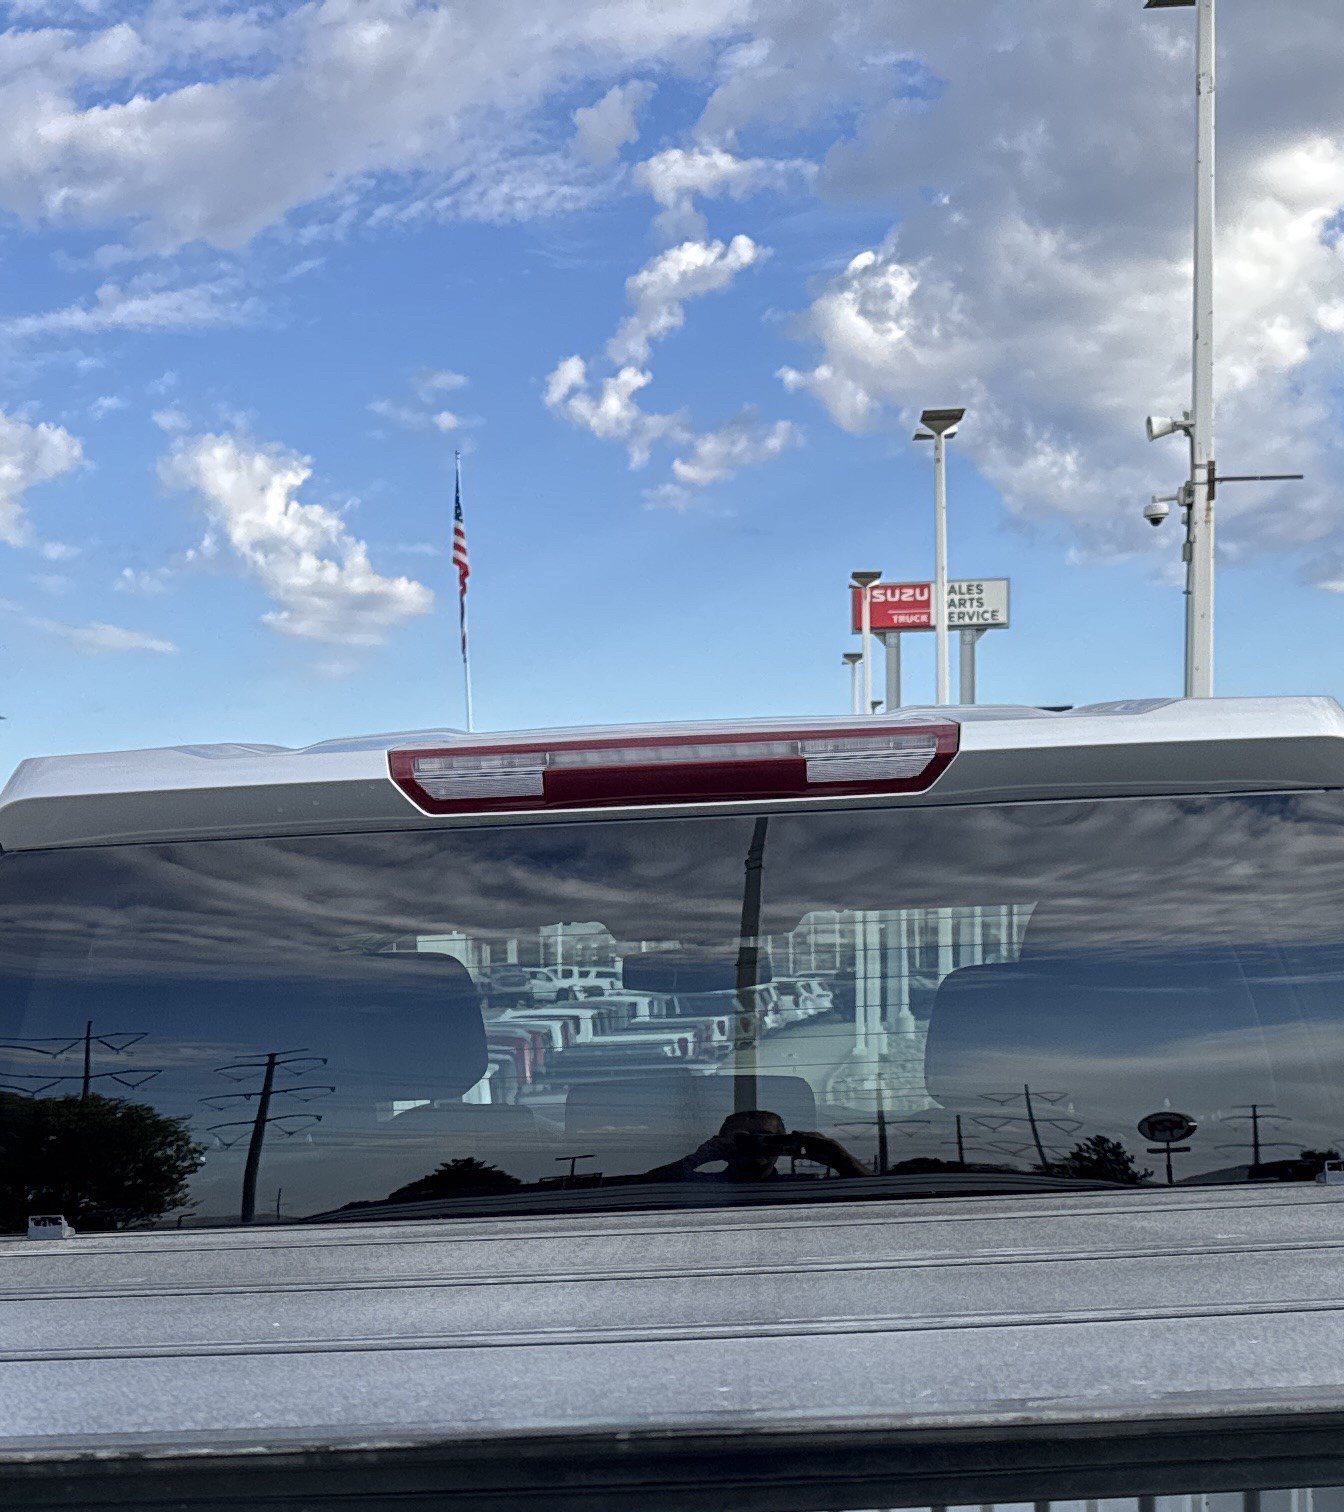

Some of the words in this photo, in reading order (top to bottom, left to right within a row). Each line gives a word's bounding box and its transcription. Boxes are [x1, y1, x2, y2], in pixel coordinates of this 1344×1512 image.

[871, 588, 929, 602] SUZU
[947, 584, 983, 596] ALES
[947, 598, 984, 609] ARTS
[892, 614, 929, 624] TRUCK
[948, 610, 999, 622] ERVICE
